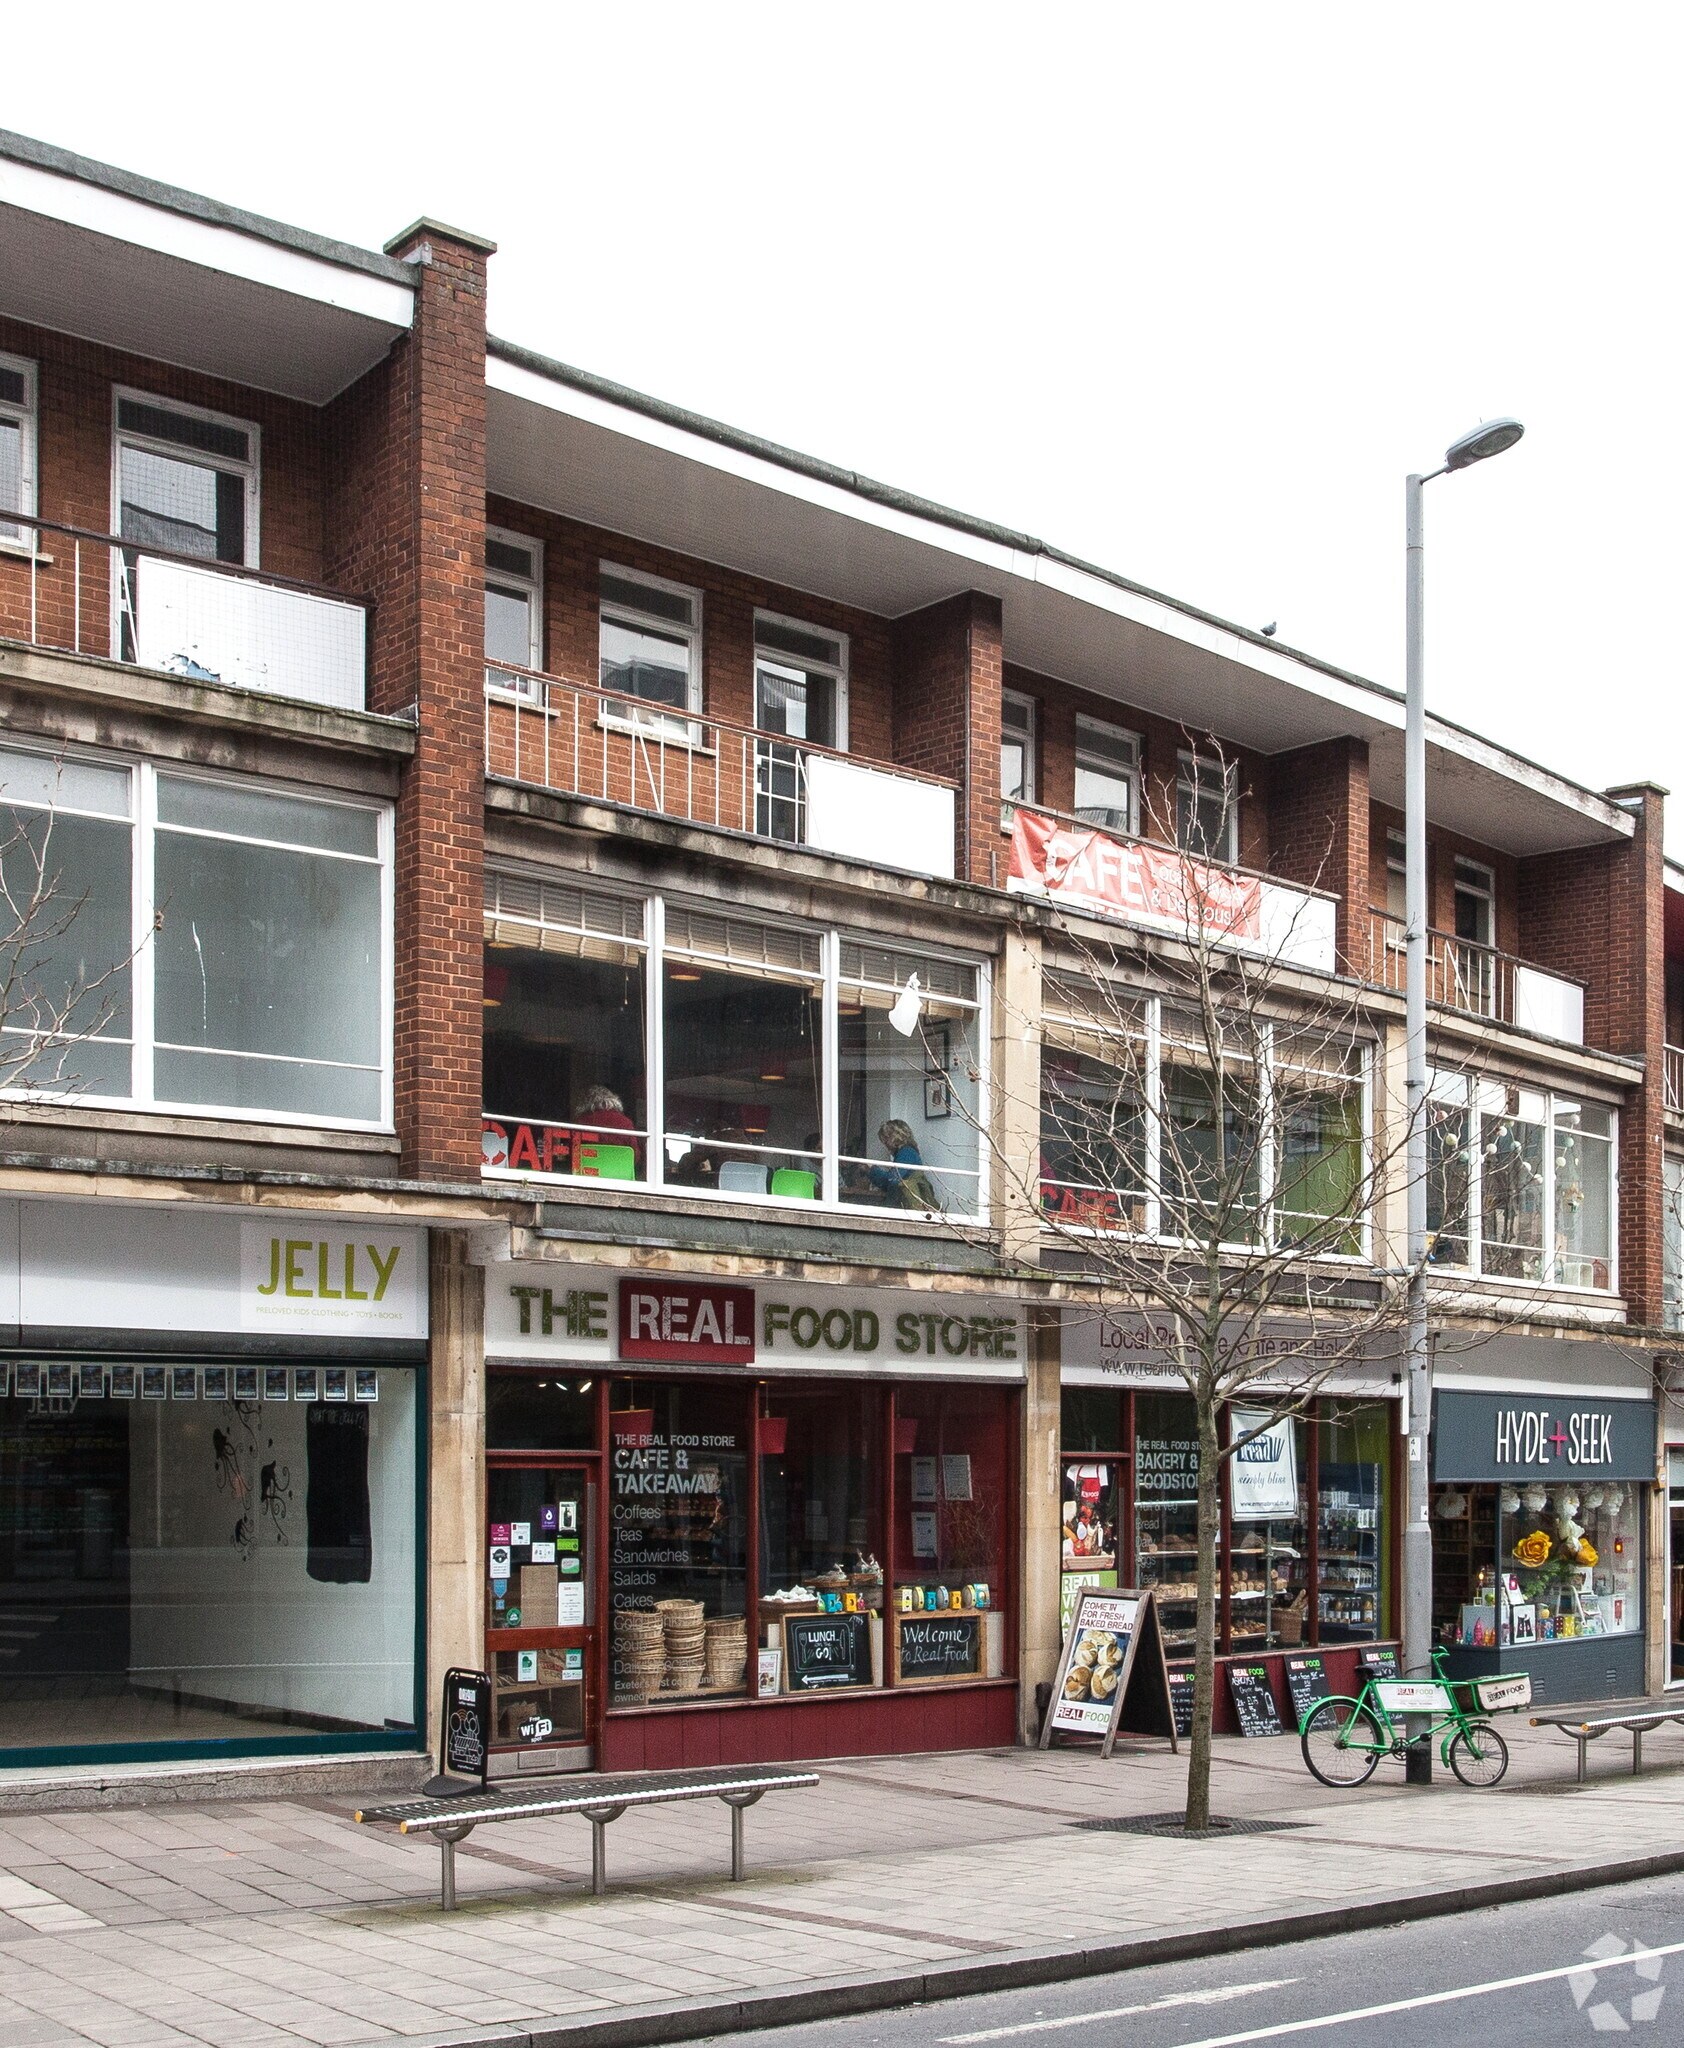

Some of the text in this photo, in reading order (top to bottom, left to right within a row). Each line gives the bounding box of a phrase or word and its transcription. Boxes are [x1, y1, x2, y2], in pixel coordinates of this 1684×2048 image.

[1042, 837, 1144, 905] CAFE
[1151, 887, 1161, 906] &
[481, 1120, 599, 1176] CAFE
[1041, 1184, 1120, 1229] CAFE
[257, 1238, 401, 1301] JELLY
[255, 1306, 403, 1321] PRELOVED KIDS CLOTHING TOYS BOOKS
[510, 1286, 1018, 1360] THE REAL FOOD STORE
[27, 1396, 80, 1413] JELLY
[615, 1434, 736, 1447] THE REAL FOOD STORE
[1136, 1440, 1150, 1450] THE
[1151, 1440, 1169, 1450] REAL
[1171, 1440, 1189, 1450] FOOD
[1497, 1411, 1549, 1464] HYDE
[1568, 1413, 1612, 1465] SEEK
[614, 1449, 689, 1470] CAFE &
[1136, 1452, 1198, 1470] BAKERY &
[614, 1473, 720, 1494] TAKEAWAY
[1238, 1472, 1286, 1488] simply bliss
[614, 1504, 661, 1519] Coffees
[1137, 1519, 1160, 1530] Bread
[613, 1526, 642, 1541] Teas
[614, 1548, 689, 1564] Sandwiches
[614, 1570, 656, 1586] Salads
[614, 1593, 653, 1609] Cakes
[1084, 1602, 1117, 1611] COME IN
[1082, 1610, 1125, 1621] FOR FRESH
[1080, 1618, 1133, 1631] BAKED BREAD
[904, 1623, 968, 1643] Welcome
[614, 1637, 647, 1654] Soup
[815, 1647, 832, 1660] GO!
[901, 1645, 969, 1664] to Real Food
[1366, 1653, 1380, 1662] REAL
[1232, 1668, 1264, 1677] REAL FOOD
[1290, 1660, 1320, 1670] REAL FOOD
[1169, 1673, 1195, 1683] REAL FO
[614, 1693, 645, 1702] owned
[1397, 1688, 1415, 1696] REAL
[1488, 1684, 1525, 1703] REAL FOOD
[1056, 1707, 1110, 1722] REAL FOOD
